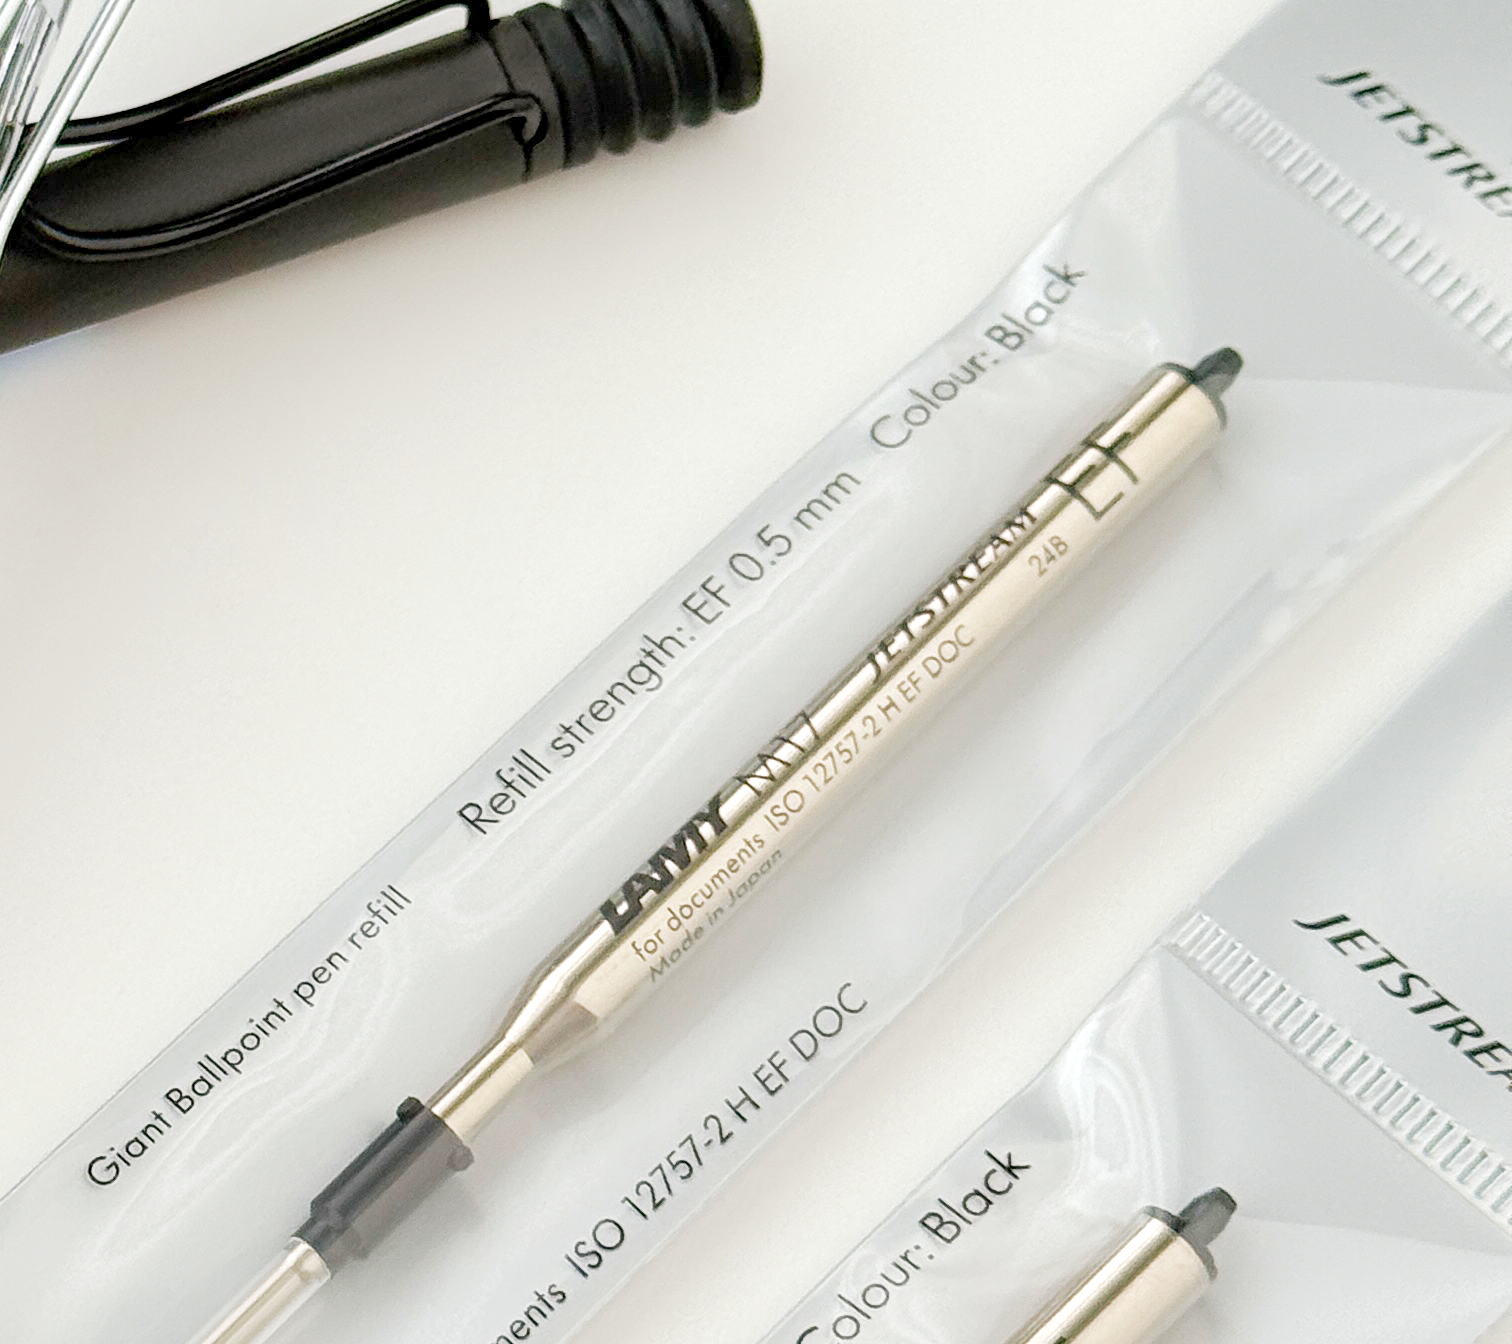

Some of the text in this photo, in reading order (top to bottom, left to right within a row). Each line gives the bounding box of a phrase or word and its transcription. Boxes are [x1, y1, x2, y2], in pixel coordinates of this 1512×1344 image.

[1316, 71, 1512, 218] JETSTRE
[457, 263, 1087, 835] Refill strength: EF 0.5 mm Colour: Black
[600, 421, 1139, 937] LAMY M17 JETSTREAM EF
[1028, 535, 1069, 578] 24B
[631, 624, 976, 963] for documents ISO 12757-2 H EF DOC
[648, 849, 784, 983] Made in Japan
[87, 884, 413, 1186] Giant Ballpoint pen refill
[564, 1218, 626, 1279] ISO
[620, 1114, 734, 1221] 12757-2
[724, 1085, 761, 1123] H
[752, 1050, 790, 1097] EF
[788, 982, 868, 1062] DOC
[918, 1149, 1032, 1244] Black
